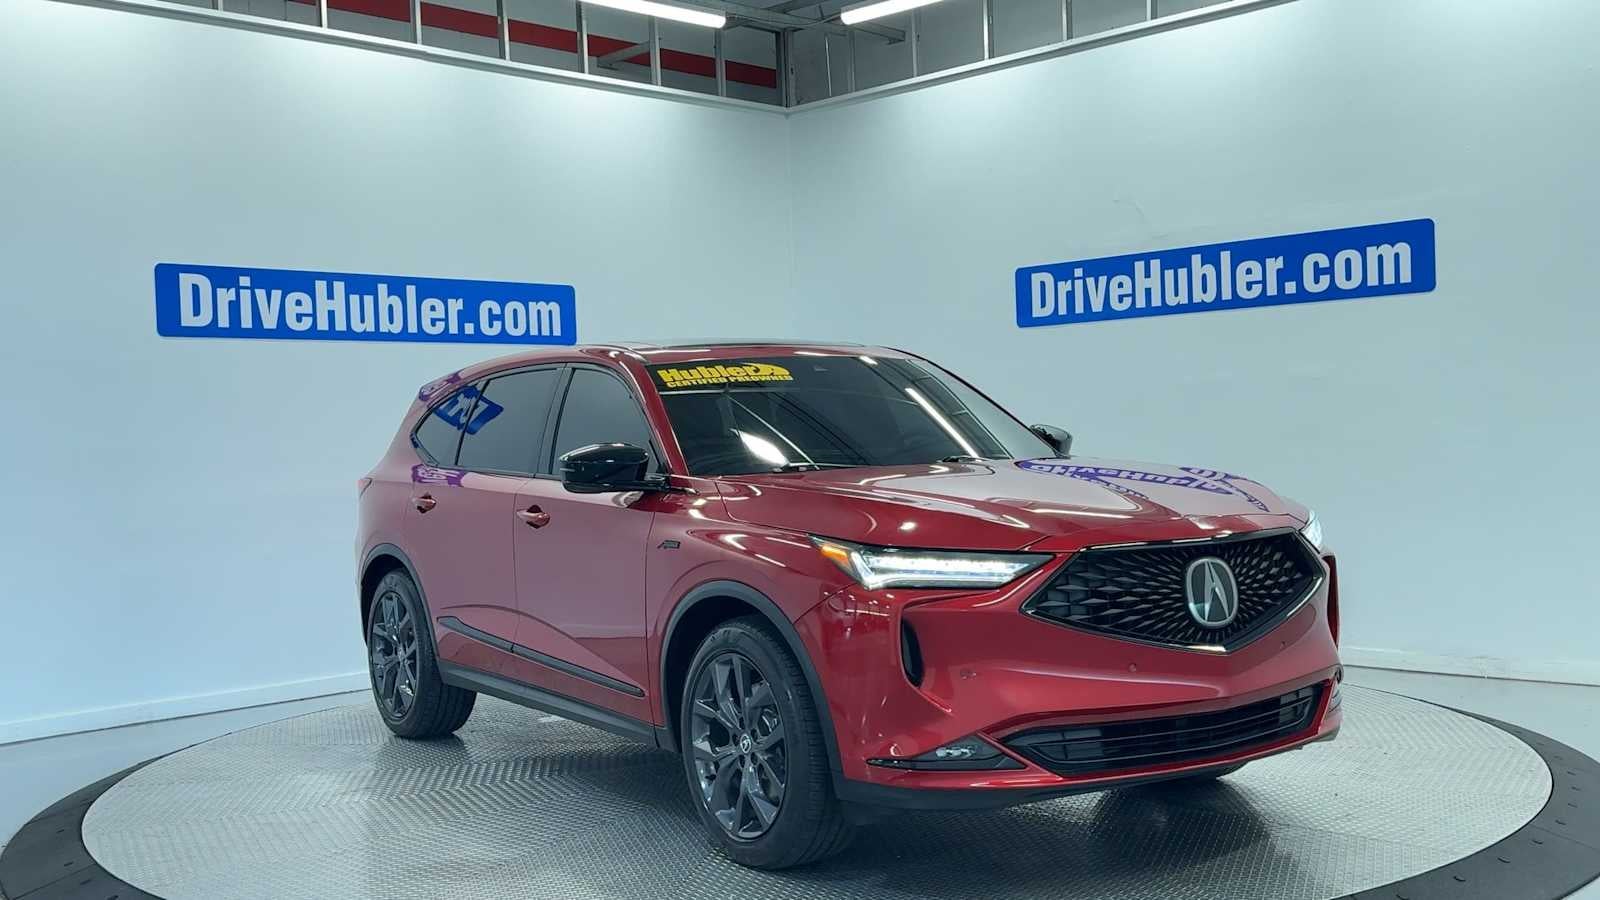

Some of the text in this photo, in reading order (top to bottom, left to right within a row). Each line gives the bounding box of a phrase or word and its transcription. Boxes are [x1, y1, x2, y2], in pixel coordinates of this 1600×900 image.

[1031, 242, 1412, 317] DriveHubler.com
[178, 272, 562, 336] DriveHubler.com
[657, 364, 768, 382] Hubler
[666, 377, 728, 388] CERTIFIED
